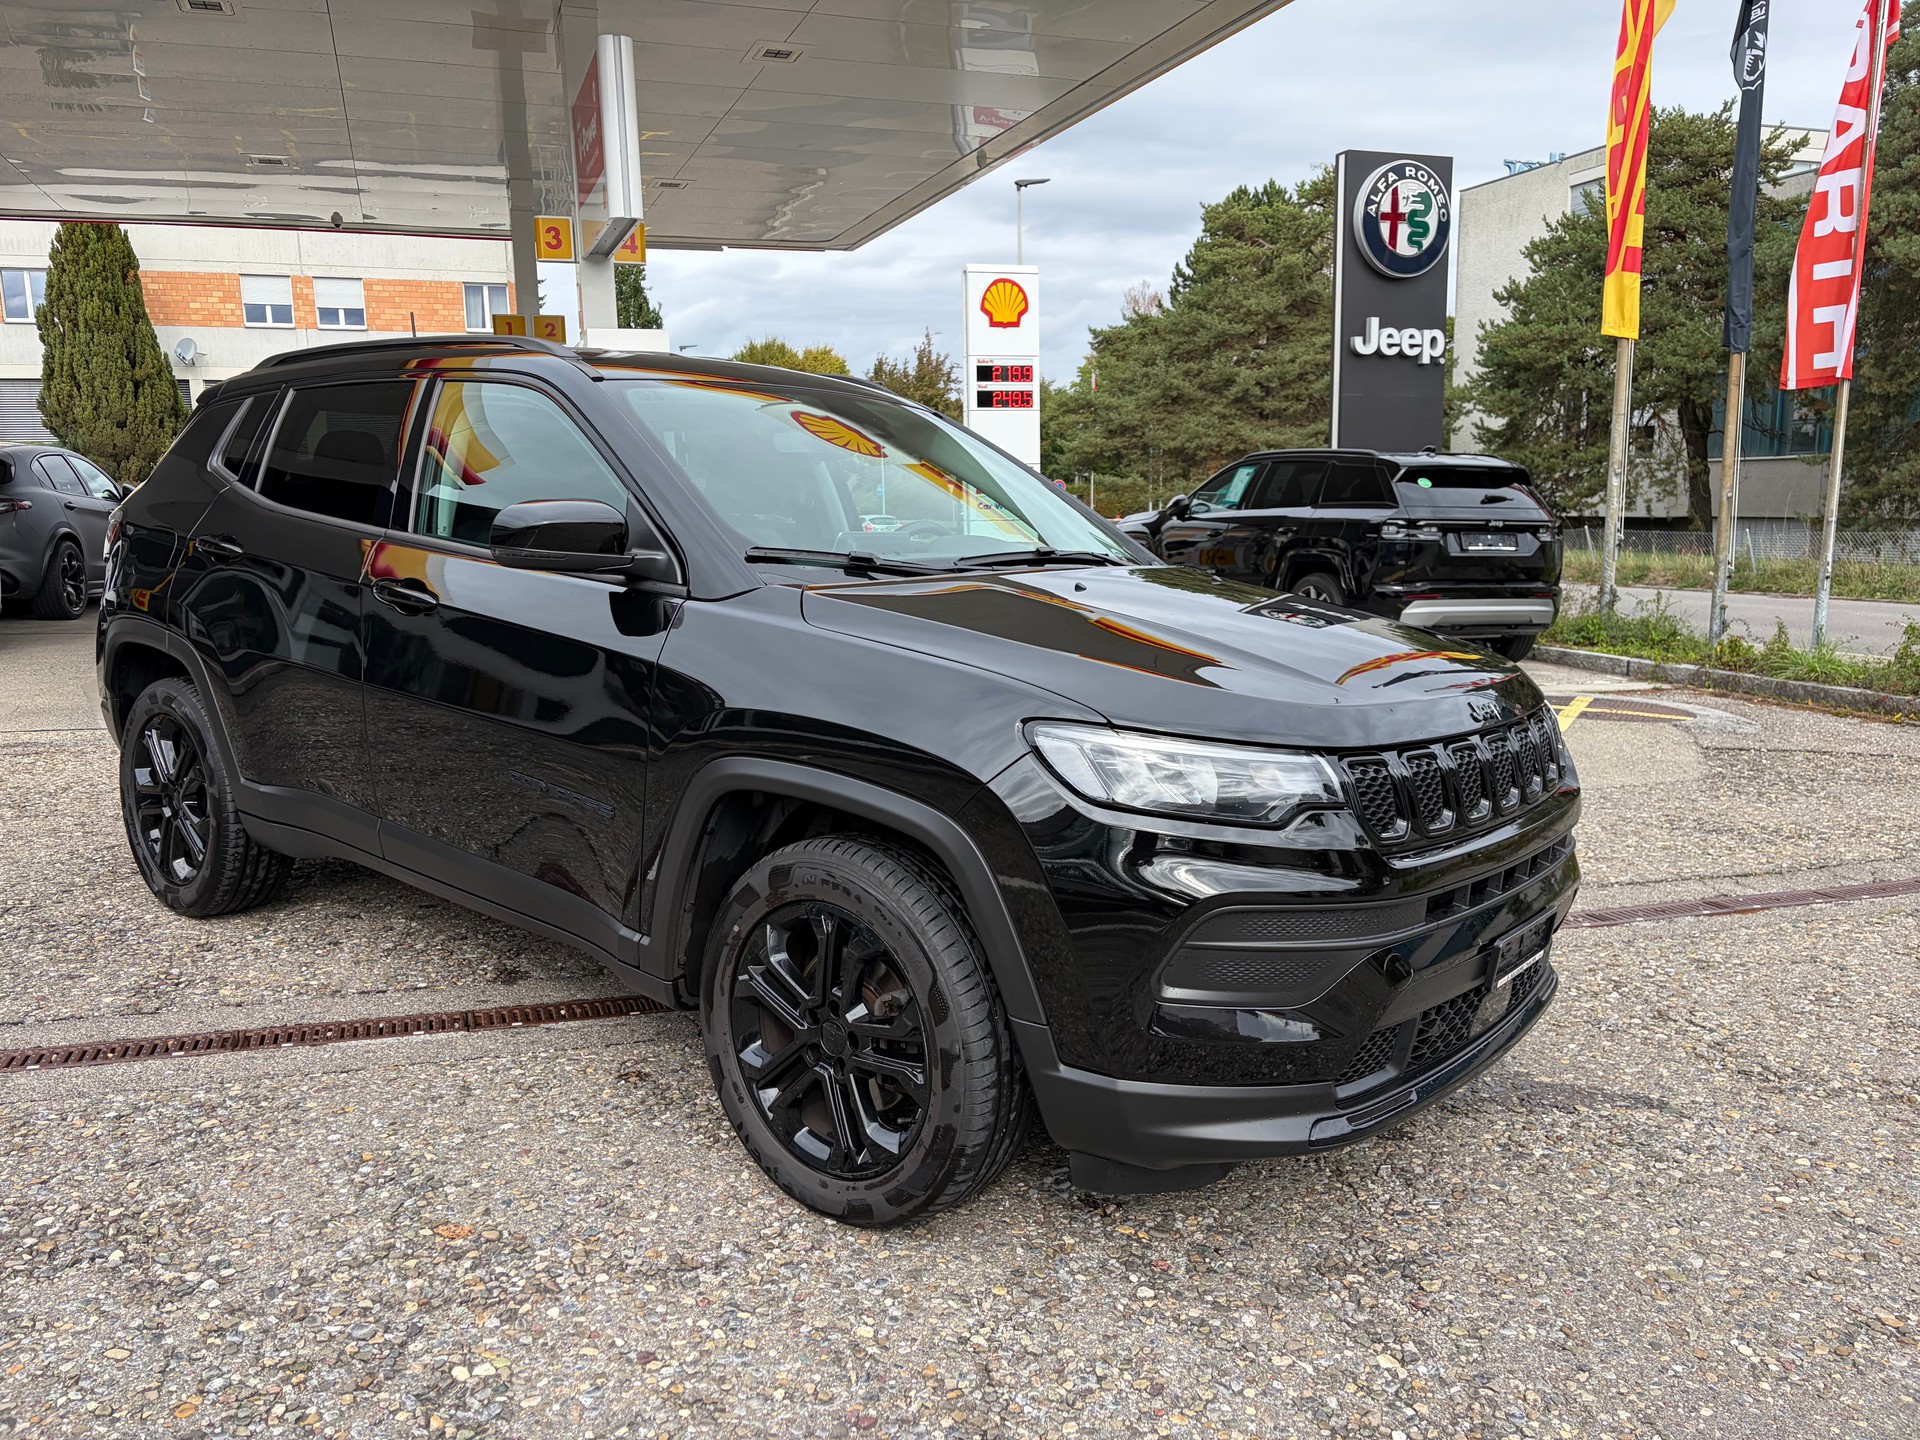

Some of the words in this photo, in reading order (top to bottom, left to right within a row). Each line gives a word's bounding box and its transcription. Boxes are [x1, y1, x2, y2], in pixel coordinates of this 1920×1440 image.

[1366, 171, 1399, 218] ALFA
[1405, 166, 1448, 223] ROMEO
[544, 226, 563, 251] 3
[620, 232, 639, 255] 4
[505, 321, 513, 336] 1
[544, 322, 557, 338] 2
[1351, 316, 1446, 365] Jeep
[992, 391, 1033, 408] 249.5
[1488, 519, 1504, 528] Jeep
